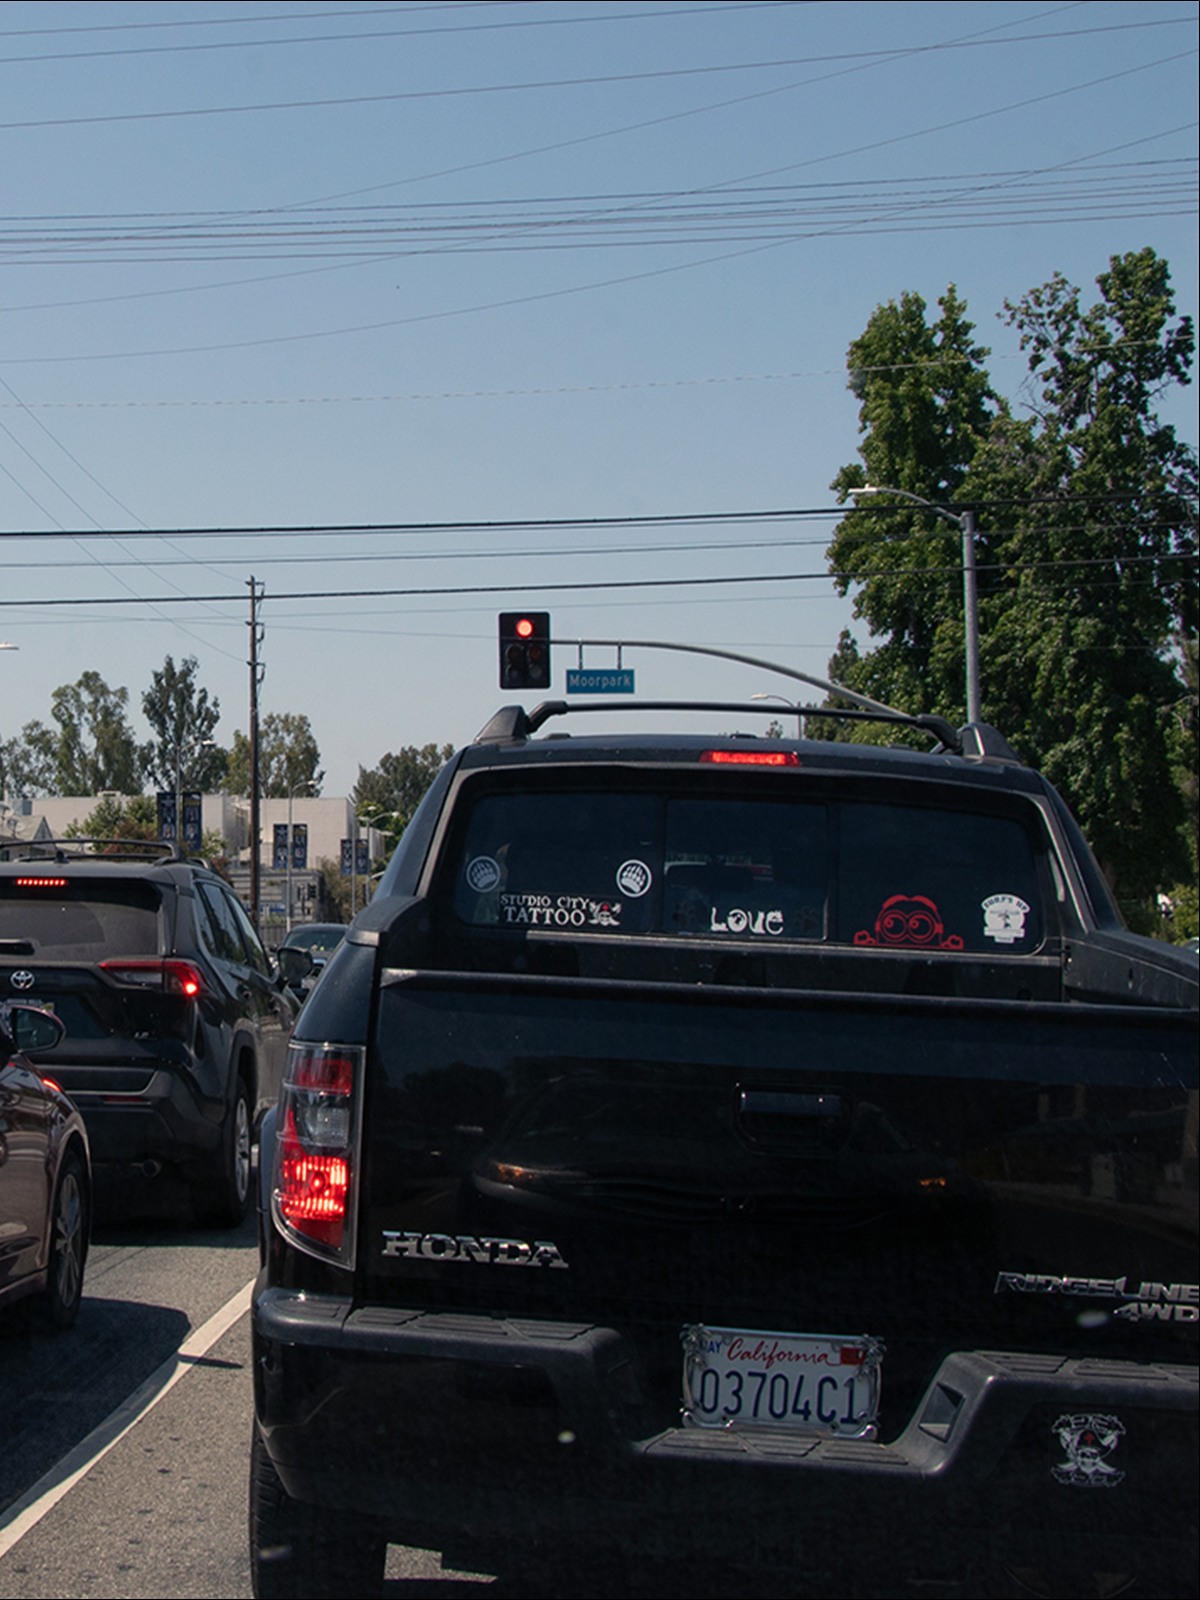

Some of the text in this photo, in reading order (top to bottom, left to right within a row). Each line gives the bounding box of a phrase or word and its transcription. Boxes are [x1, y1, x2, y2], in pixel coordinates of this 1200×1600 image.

[569, 674, 631, 690] Moorpark
[501, 894, 590, 910] STUDIO CITY
[503, 906, 586, 926] TATTOO
[382, 1230, 569, 1268] HONDA
[994, 1271, 1199, 1302] RIDGELINE
[1114, 1303, 1199, 1322] 4WD
[727, 1337, 841, 1369] California
[700, 1368, 860, 1425] 03704C1
